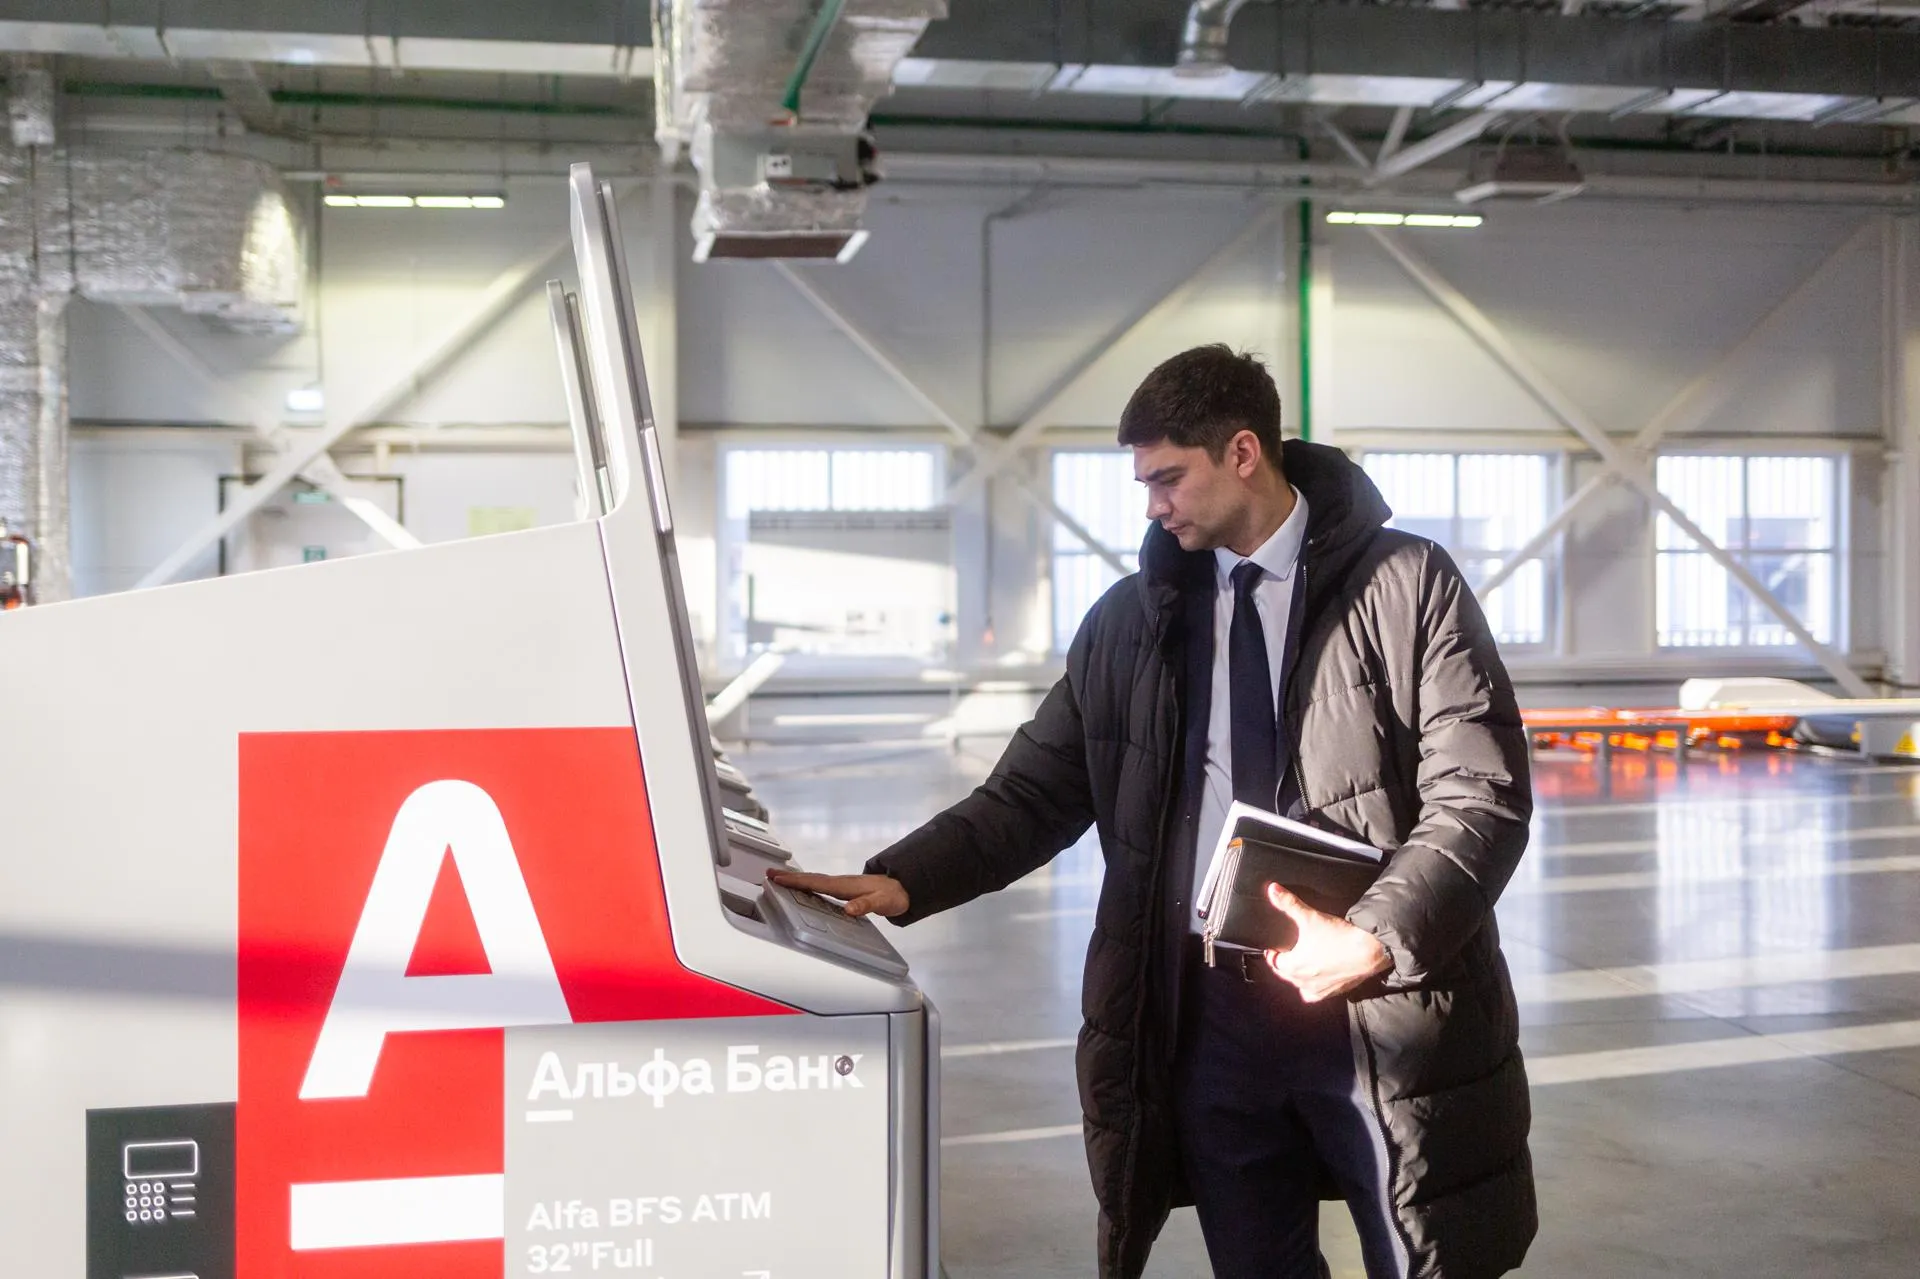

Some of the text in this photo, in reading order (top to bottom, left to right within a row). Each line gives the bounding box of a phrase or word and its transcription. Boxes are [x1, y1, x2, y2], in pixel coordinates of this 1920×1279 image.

[527, 1045, 865, 1108] Альфа Банк
[526, 1192, 771, 1231] Alfa BFS ATM
